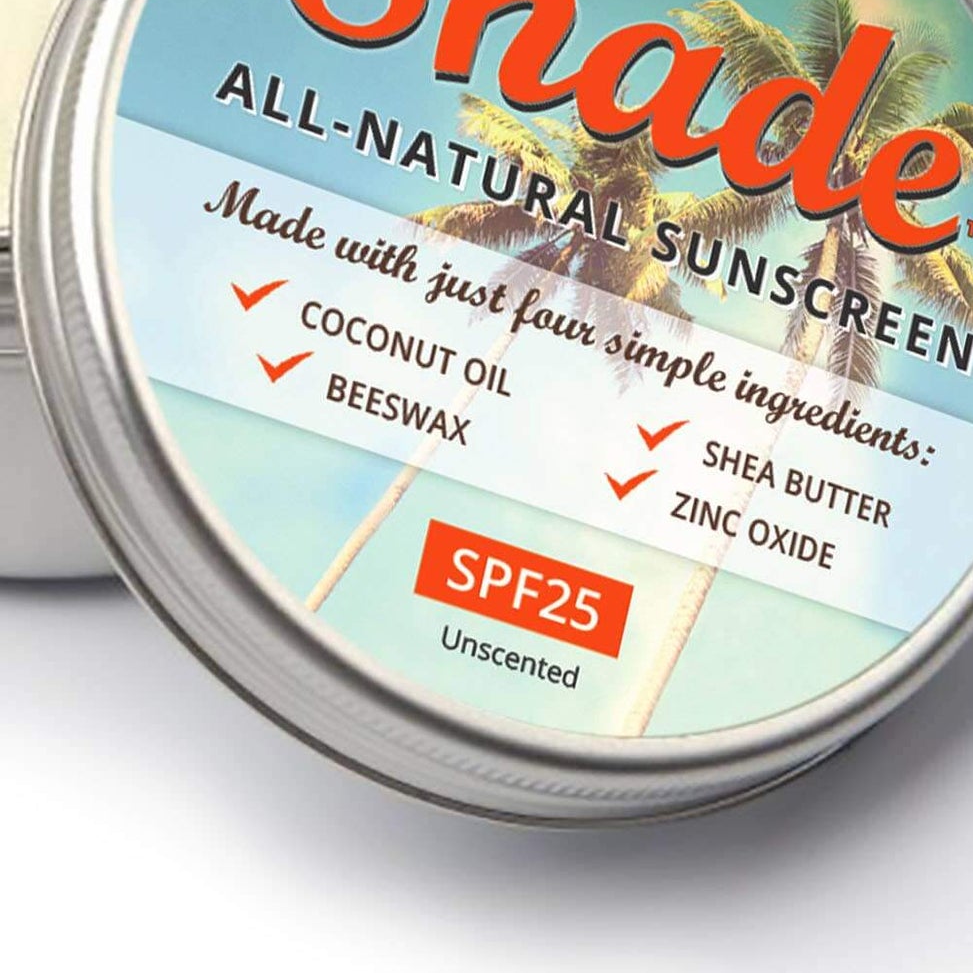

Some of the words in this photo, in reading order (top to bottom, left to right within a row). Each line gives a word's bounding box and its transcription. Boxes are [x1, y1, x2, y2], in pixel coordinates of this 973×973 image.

[215, 62, 630, 249] ALL-NATURAL
[203, 181, 325, 250] Made
[335, 239, 418, 282] with
[425, 262, 507, 313] just
[513, 291, 596, 347] four
[605, 331, 727, 391] simple
[735, 370, 936, 467] ingredients:
[301, 301, 457, 375] COCONUT
[464, 357, 511, 397] OIL
[326, 374, 472, 446] BEESWAX
[703, 439, 776, 488] SHEA
[784, 468, 892, 528] BUTTER
[670, 491, 741, 537] ZINC
[748, 518, 836, 570] OXIDE
[446, 547, 602, 633] SPF25
[441, 625, 580, 690] Unscented
